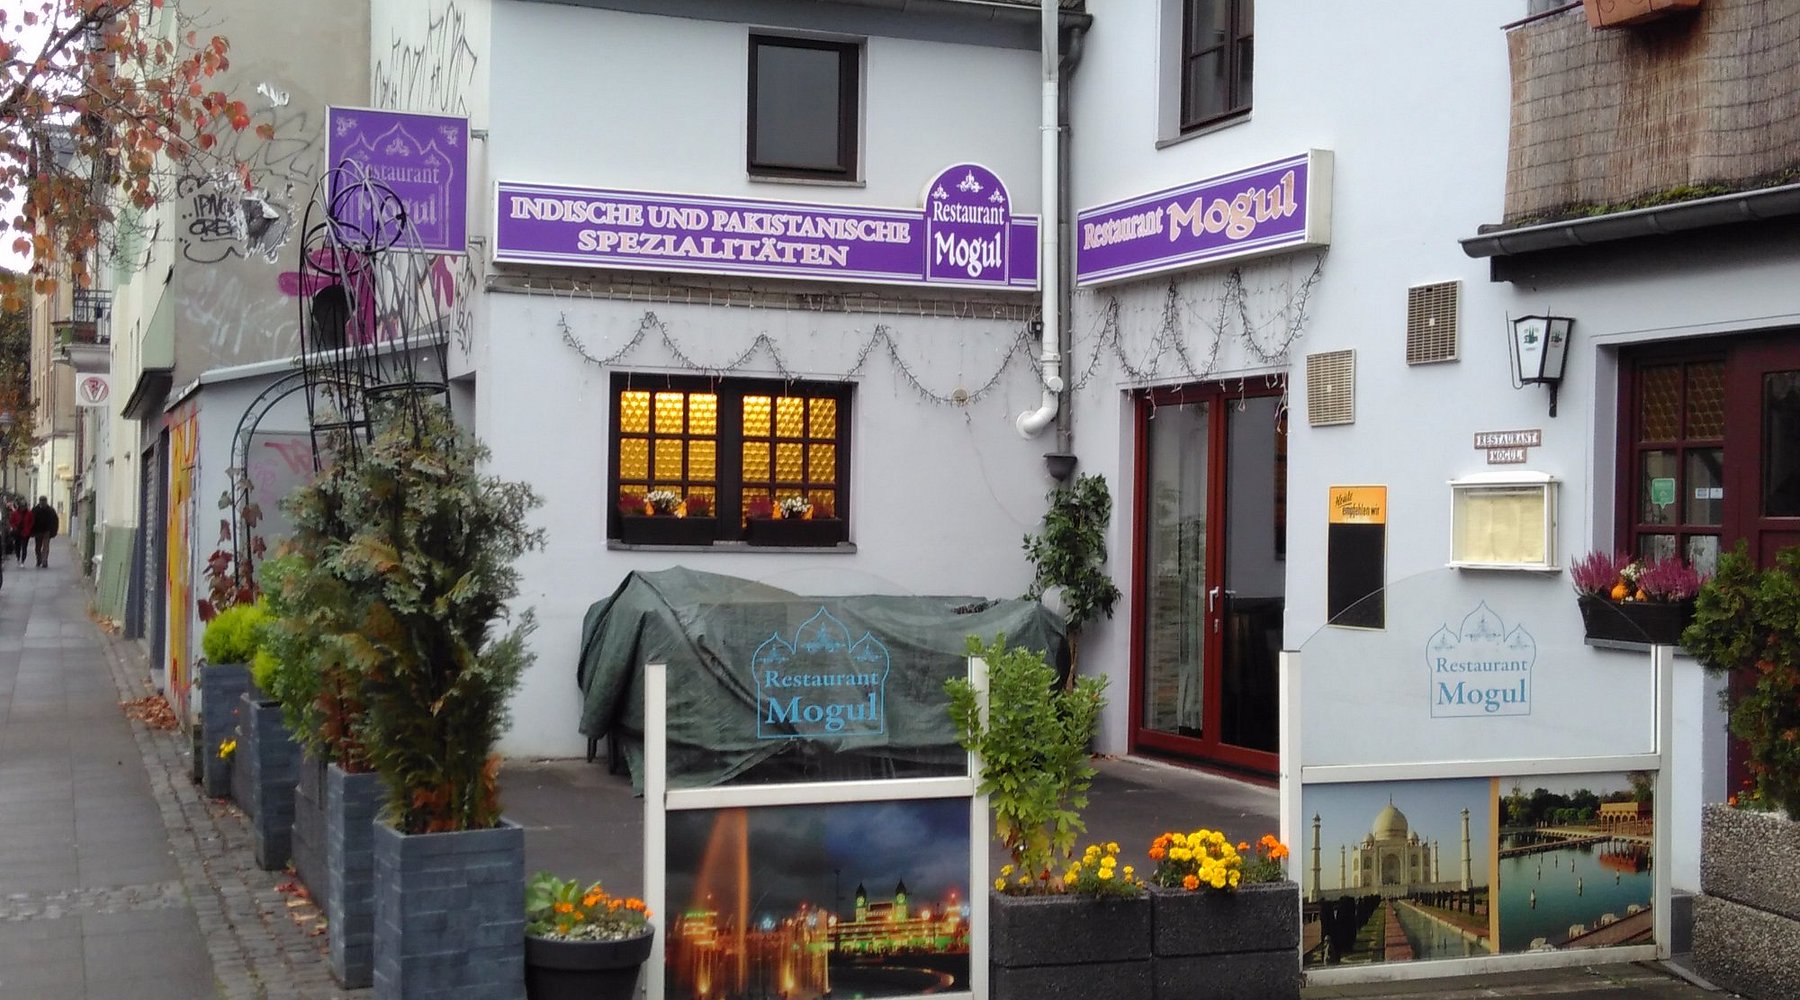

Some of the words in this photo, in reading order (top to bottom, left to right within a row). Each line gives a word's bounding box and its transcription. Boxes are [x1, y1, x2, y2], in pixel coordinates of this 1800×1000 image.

[510, 196, 644, 226] INDISCHE
[647, 205, 709, 231] UND
[711, 209, 911, 244] PAKISTANISCHE
[932, 200, 1005, 225] Restaurant
[1083, 206, 1164, 250] Restaurant
[1166, 170, 1298, 242] Mogul
[577, 229, 849, 267] SPEZIALITÄTEN
[934, 231, 1002, 277] Mogul
[1478, 432, 1537, 446] RESTAURANT
[1491, 449, 1523, 461] MOGUL
[1371, 504, 1380, 516] wir
[764, 670, 879, 688] Restaurant
[1436, 657, 1528, 673] Restaurant
[1437, 679, 1526, 712] Mogul
[764, 693, 878, 731] Mogul
